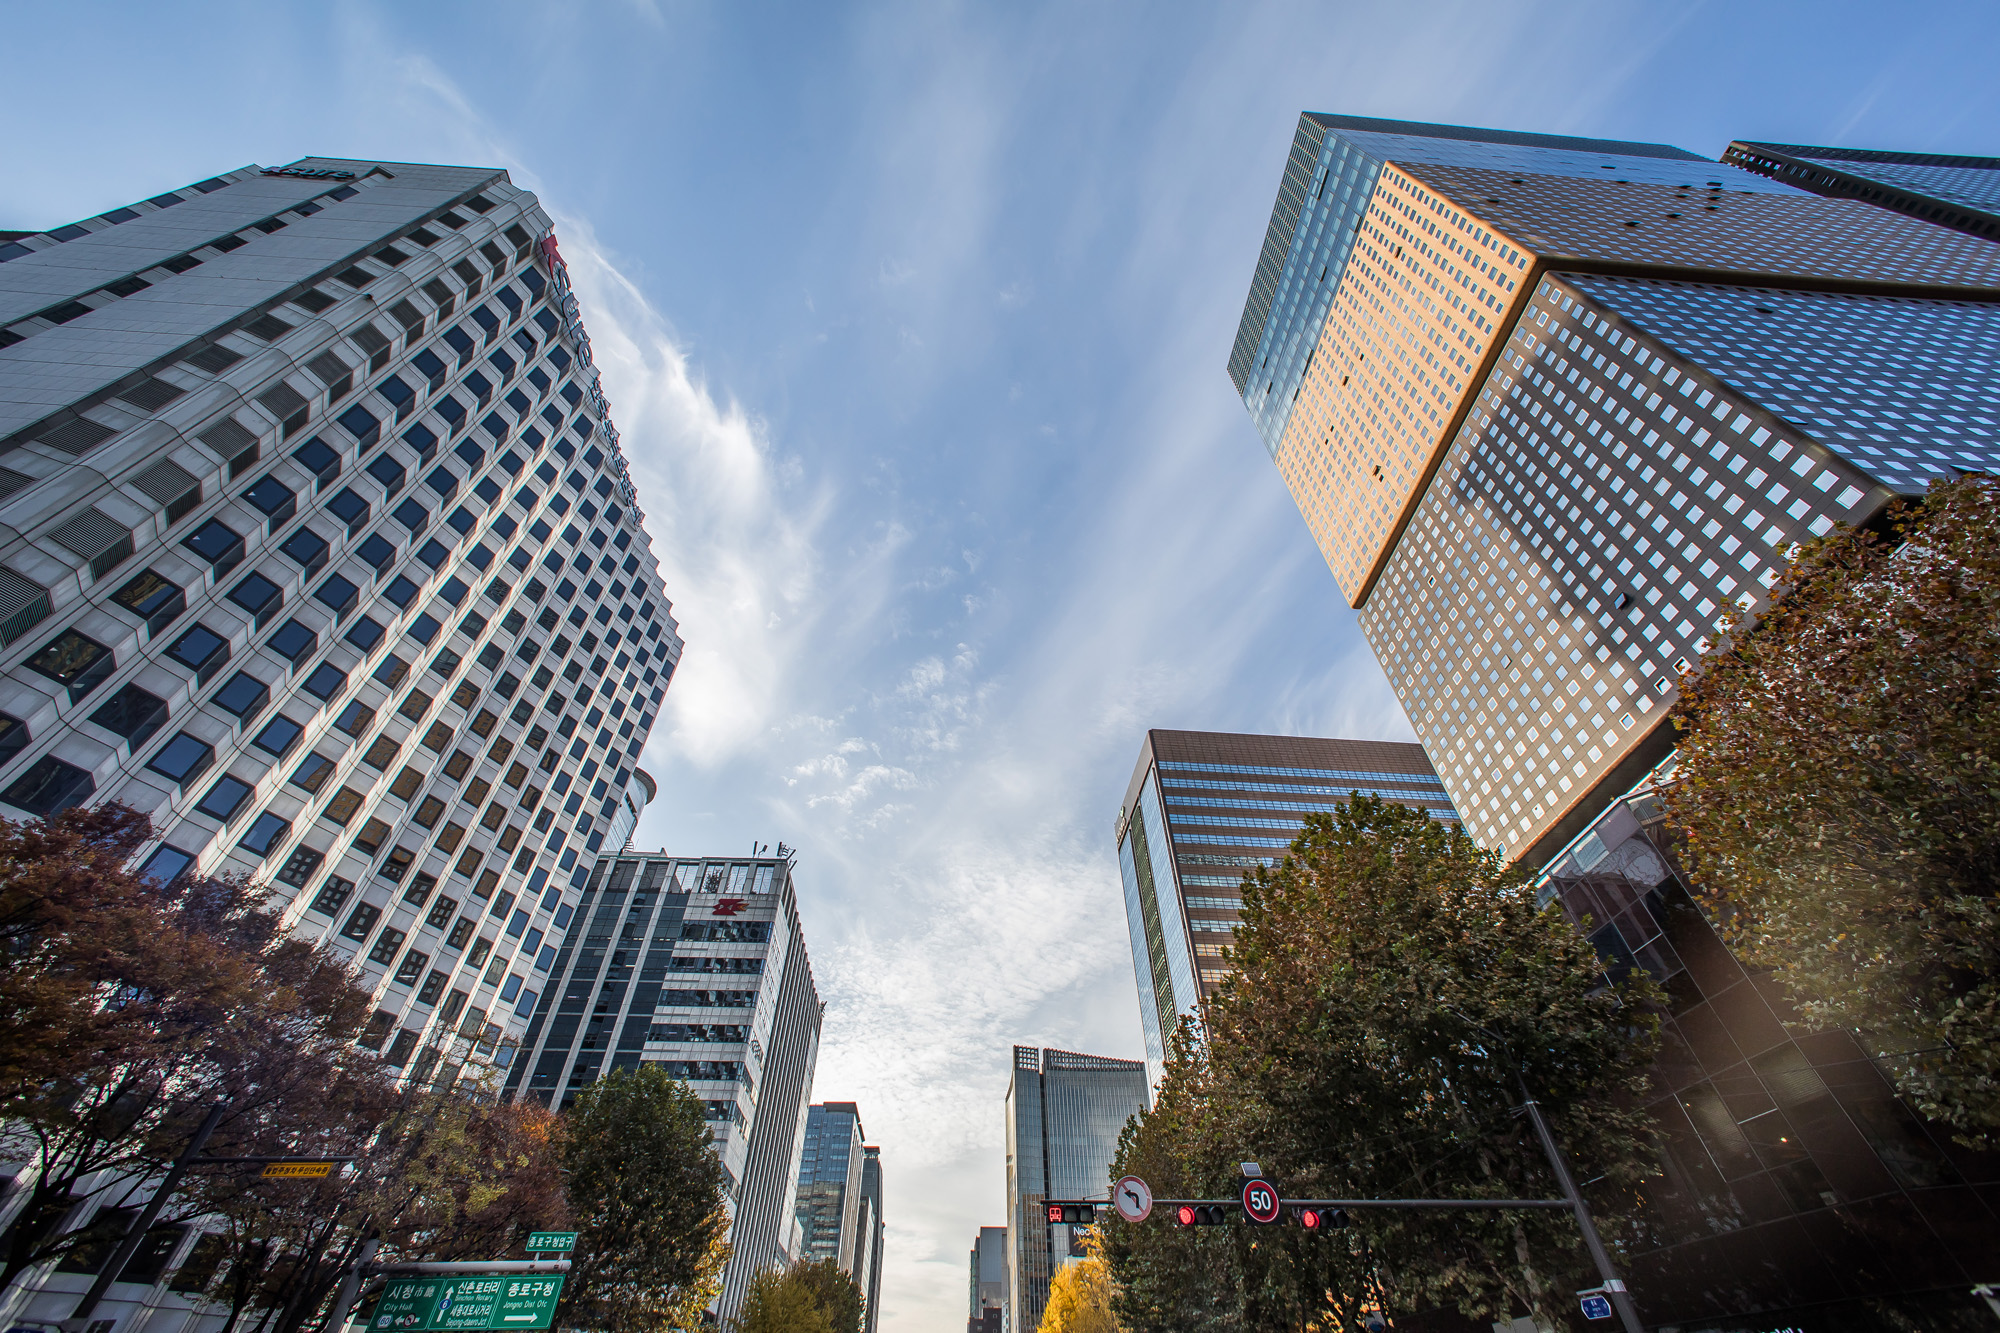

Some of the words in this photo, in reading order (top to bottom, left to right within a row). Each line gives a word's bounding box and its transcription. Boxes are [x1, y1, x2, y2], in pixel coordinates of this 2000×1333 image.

[1250, 1190, 1272, 1211] 50
[1073, 1226, 1091, 1236] Neo
[388, 1284, 415, 1300] 시청
[457, 1280, 502, 1294] 신촌로터리
[508, 1281, 555, 1298] 종로구청
[442, 1300, 448, 1309] 6
[475, 1294, 494, 1302] Rotary
[384, 1302, 398, 1312] City
[399, 1303, 413, 1311] Hall
[450, 1303, 492, 1317] 세종대로사거리
[503, 1300, 523, 1311] Jongno
[524, 1299, 536, 1309] Dist
[537, 1299, 548, 1309] Ofc
